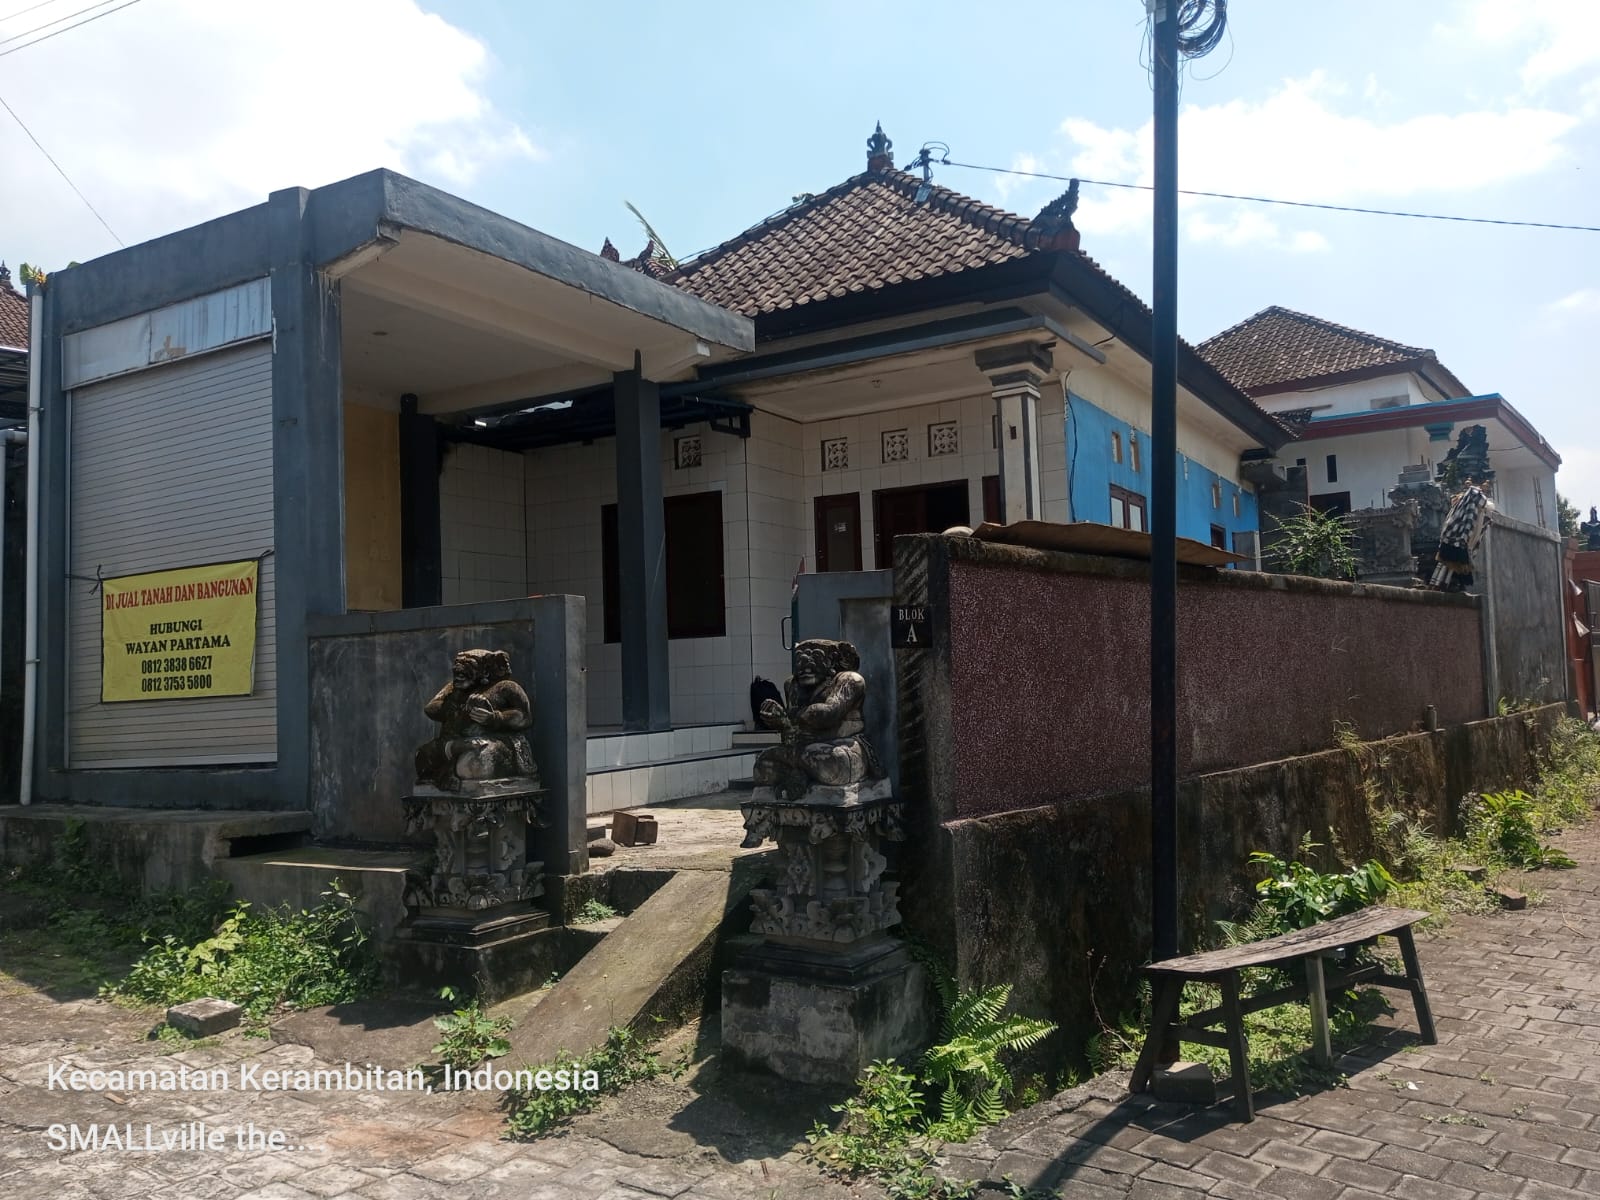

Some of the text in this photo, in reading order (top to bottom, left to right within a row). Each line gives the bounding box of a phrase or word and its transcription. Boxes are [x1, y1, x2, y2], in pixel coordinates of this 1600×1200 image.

[106, 577, 254, 610] DI JUAL TANAH DAN BANGUNAN
[899, 608, 924, 620] BLOK
[150, 619, 203, 635] HUBUNGI
[906, 623, 917, 642] A
[125, 635, 231, 655] WAYAN PARTAMA
[141, 655, 213, 674] 0812 3838 6627
[141, 674, 212, 692] 0812 3753 5800
